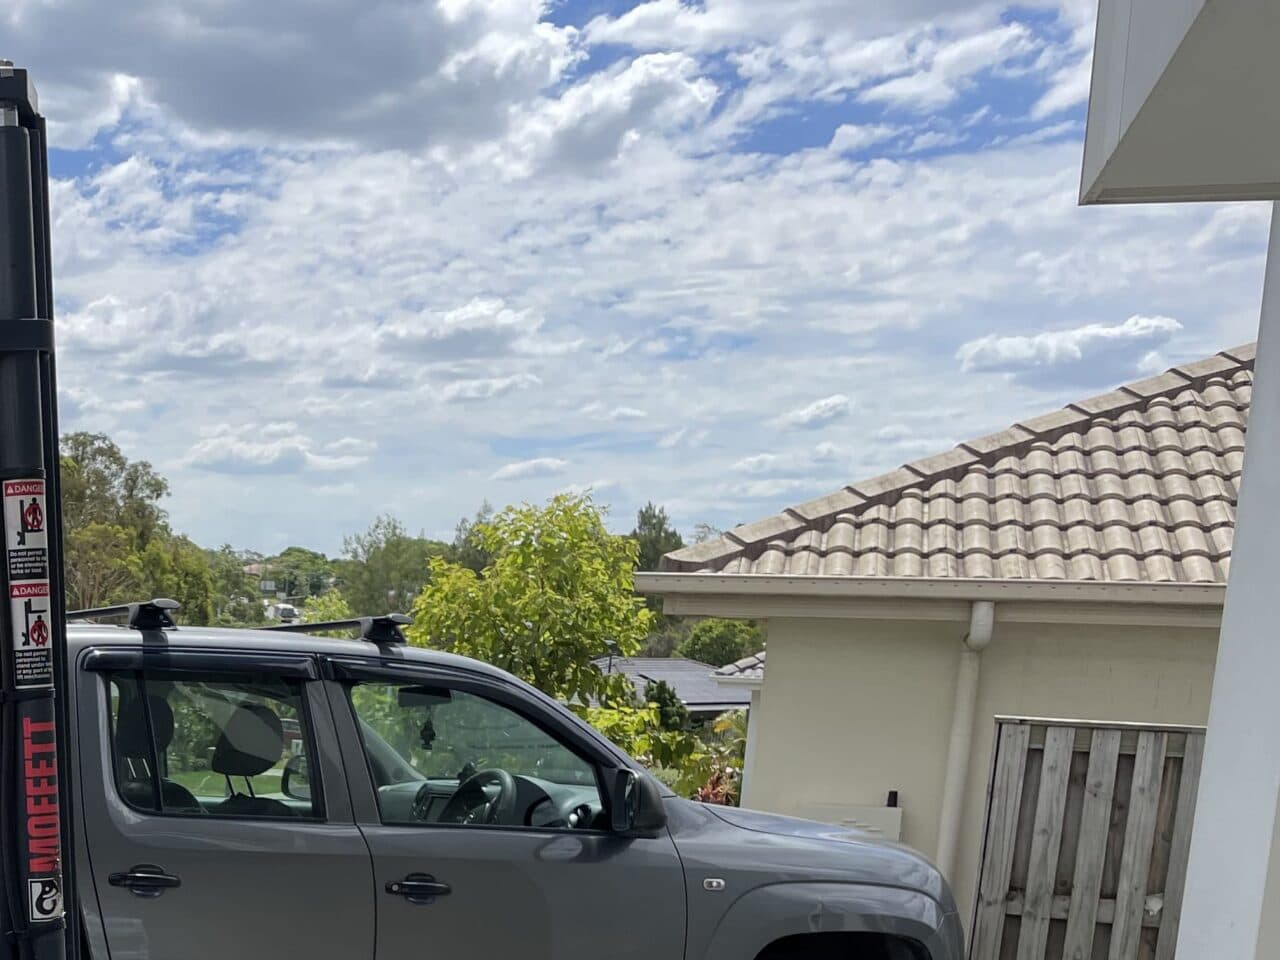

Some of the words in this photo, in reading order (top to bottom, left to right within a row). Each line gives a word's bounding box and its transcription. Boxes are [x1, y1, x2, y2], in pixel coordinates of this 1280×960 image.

[14, 484, 44, 493] DANGE
[19, 586, 48, 595] DANGE
[23, 717, 61, 873] MOFFETT
